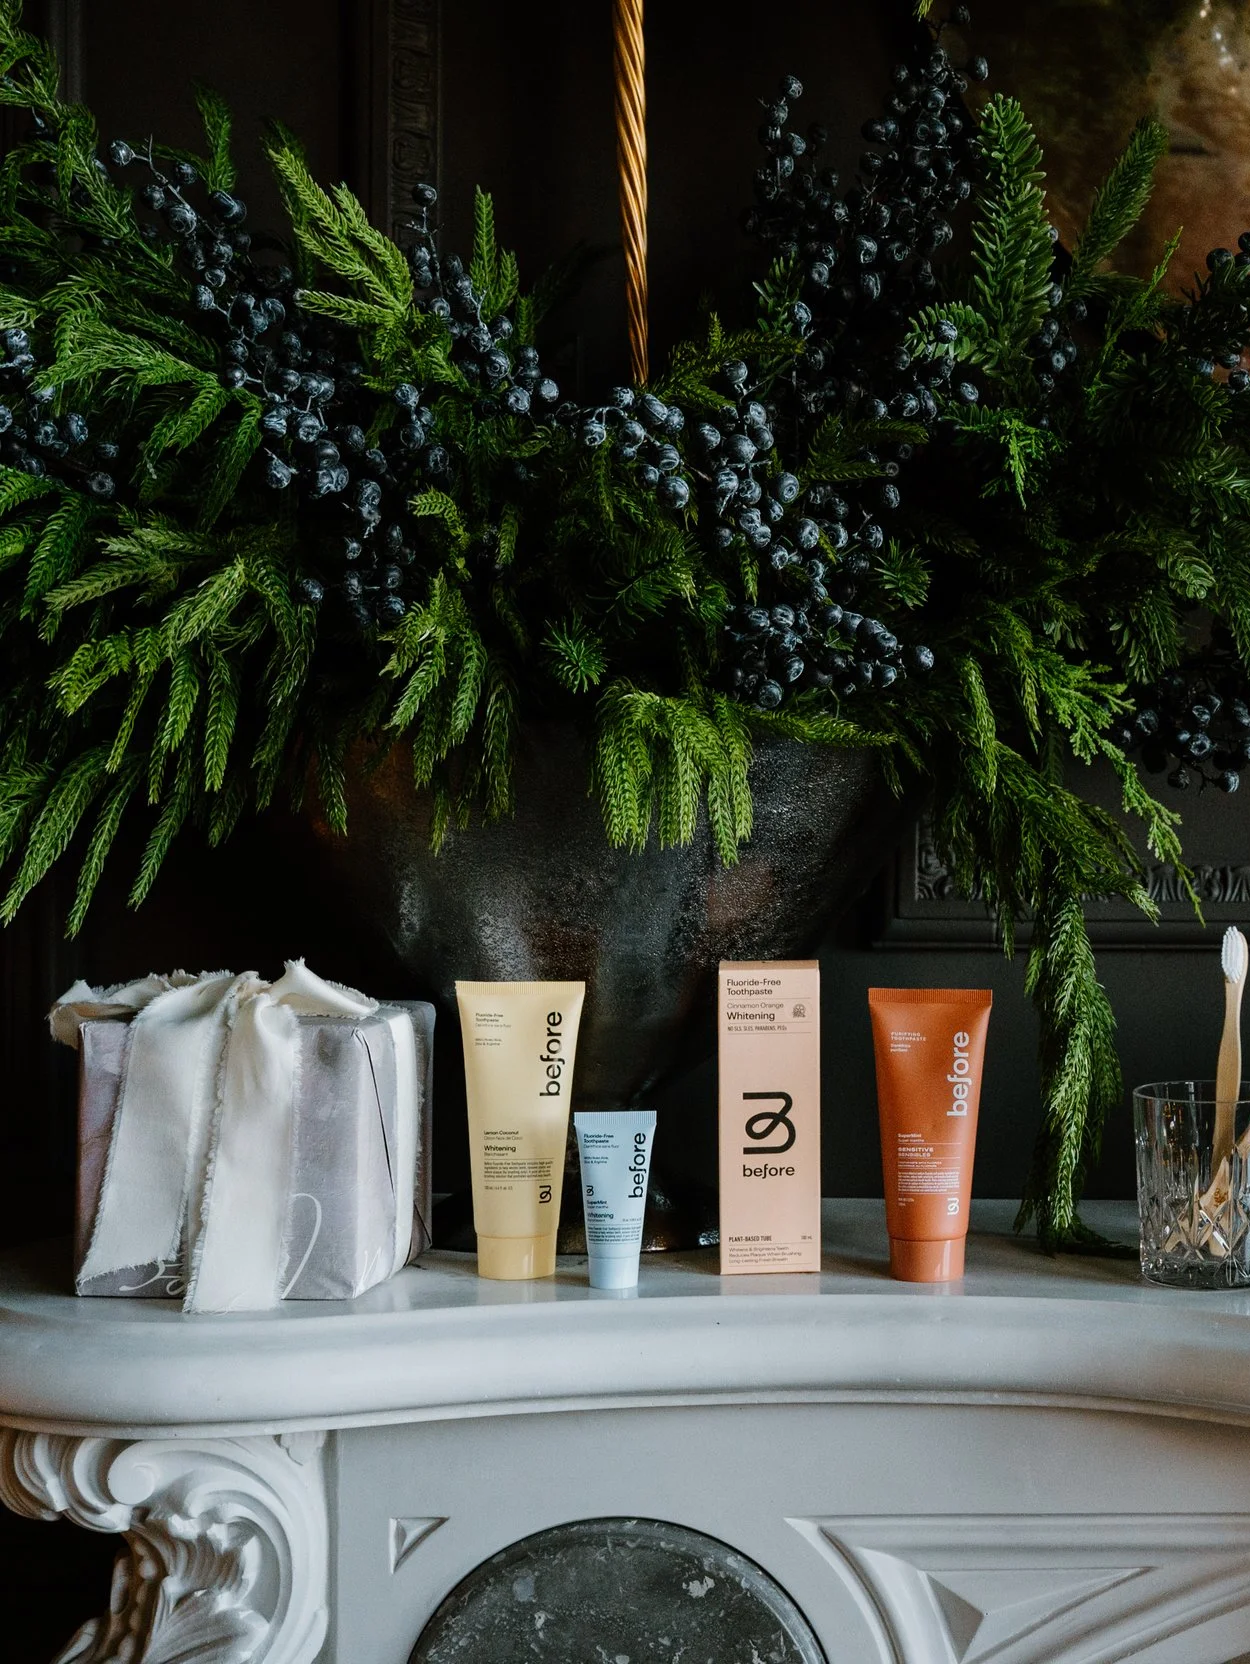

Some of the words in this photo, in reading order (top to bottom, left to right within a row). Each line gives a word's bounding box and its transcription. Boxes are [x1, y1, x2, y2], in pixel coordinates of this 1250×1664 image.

[727, 978, 781, 987] Fluoride-Free
[727, 988, 773, 996] Toothpaste
[726, 1011, 776, 1021] Whitening
[539, 1011, 566, 1097] before
[946, 1031, 972, 1116] before
[628, 1132, 647, 1198] before
[742, 1163, 795, 1179] before
